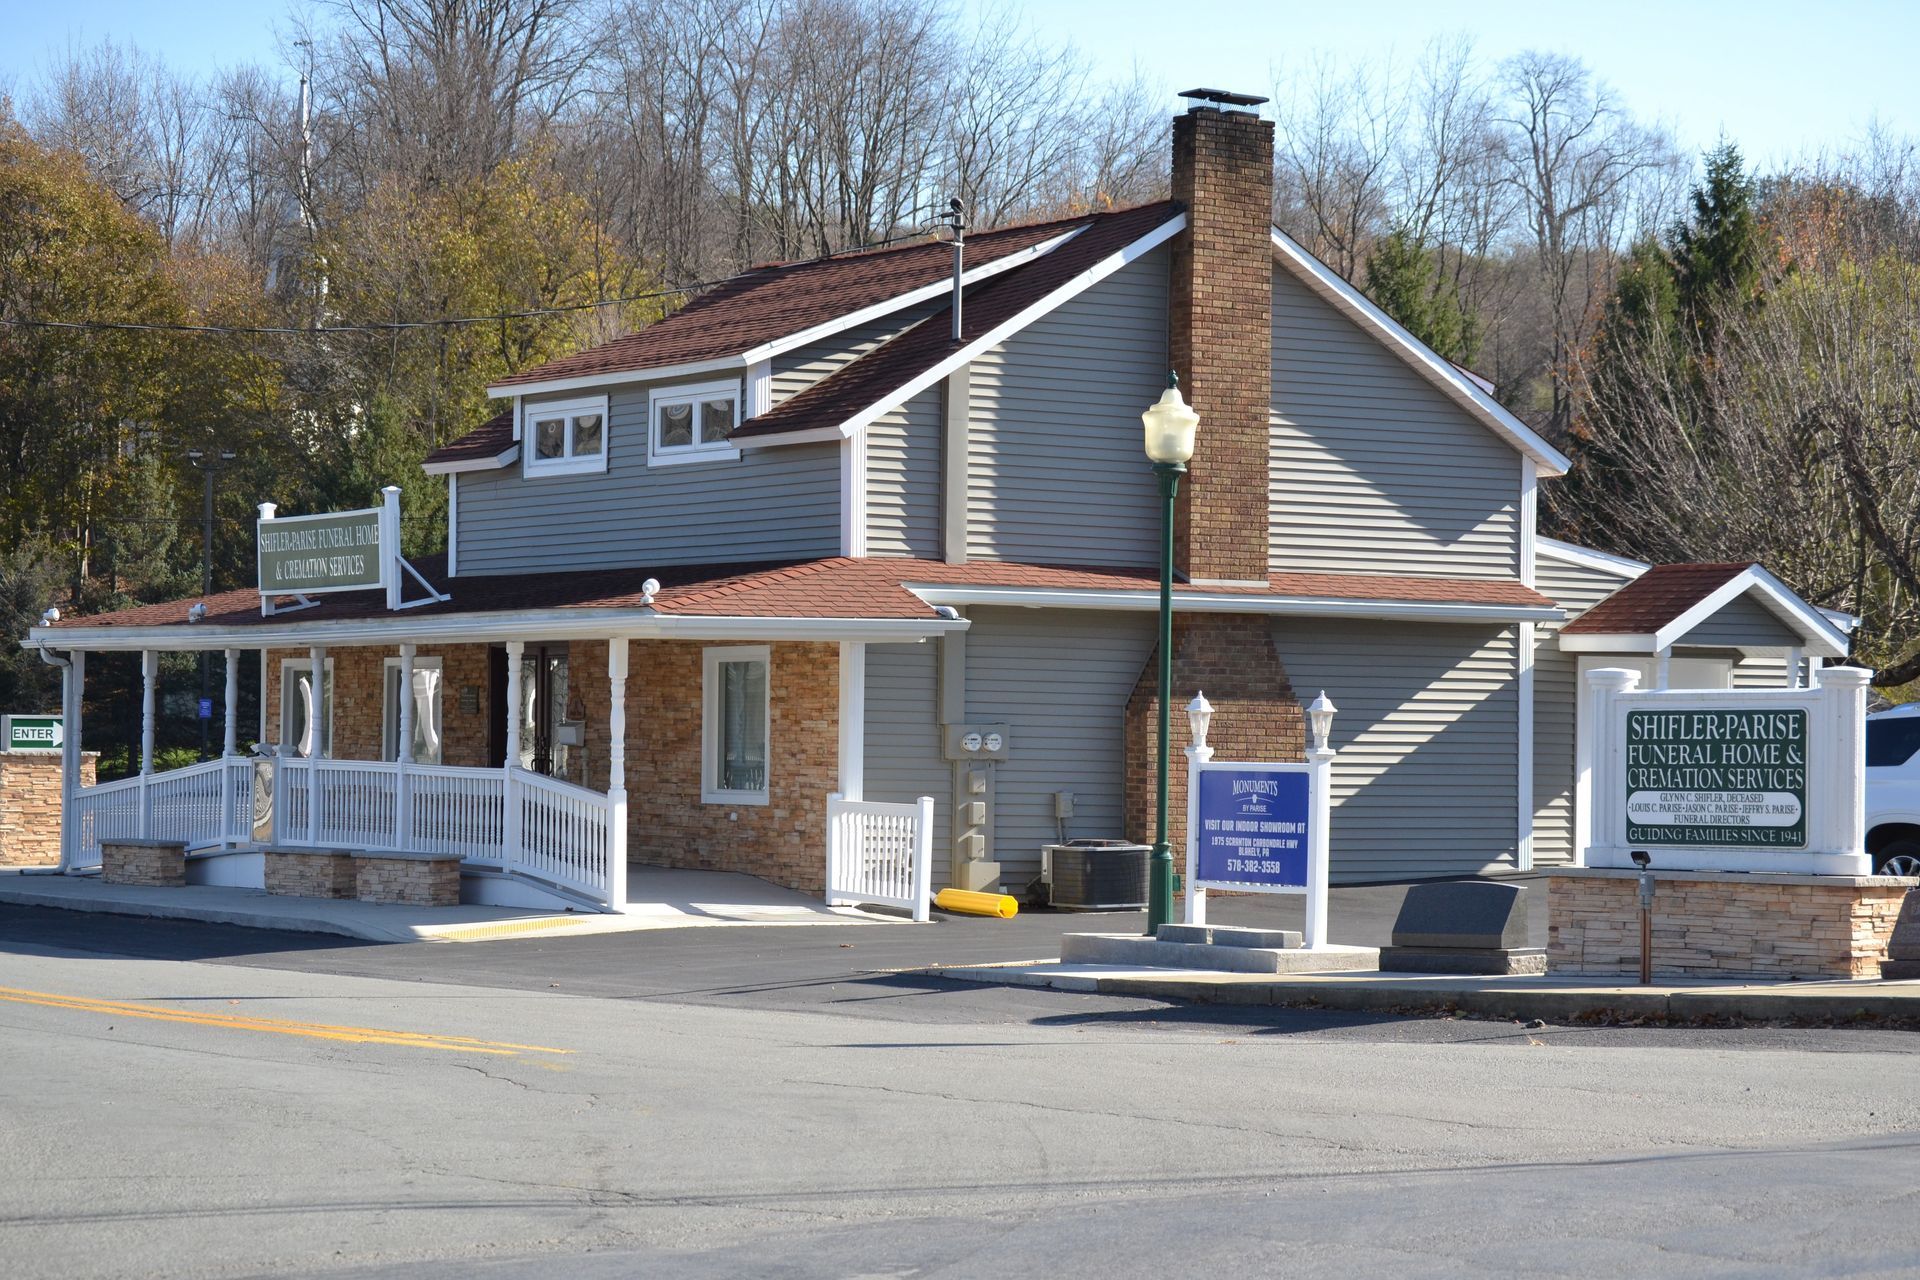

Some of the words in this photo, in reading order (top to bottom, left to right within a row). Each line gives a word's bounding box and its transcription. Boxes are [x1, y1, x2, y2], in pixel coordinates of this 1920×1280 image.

[260, 529, 317, 553] SHIFLER-PARISE
[318, 526, 355, 549] FUNERAL
[355, 524, 379, 546] HOME
[275, 561, 283, 580] &
[284, 557, 328, 580] CREMATION
[329, 555, 365, 577] SERVICES
[13, 728, 54, 739] ENTER
[1631, 714, 1801, 741] SHIFLER-PARISE
[1628, 744, 1717, 765] FUNERAL
[1721, 744, 1781, 765] HOME
[1786, 744, 1805, 765] &
[1627, 768, 1724, 789] CREMATION
[1727, 768, 1804, 790] SERVICES
[1232, 779, 1278, 797] MONUMENTS
[1660, 792, 1686, 802] GLYNN
[1694, 793, 1725, 804] SHIFLER,
[1726, 793, 1764, 803] DECEASED
[1242, 804, 1250, 812] BY
[1250, 804, 1267, 813] PARISE
[1204, 819, 1221, 831] VISIT
[1221, 820, 1234, 832] OUR
[1235, 820, 1259, 832] INDOOR
[1260, 821, 1296, 834] SHOWROOM
[1297, 822, 1306, 834] AT
[1674, 814, 1709, 824] FUNERAL
[1709, 814, 1751, 825] DIRECTORS
[1211, 836, 1225, 846] 1975
[1629, 827, 1682, 841] GUIDING
[1685, 828, 1739, 841] FAMILIES
[1741, 829, 1777, 842] SINCE
[1781, 830, 1803, 843] 1941
[1262, 847, 1270, 857] PA
